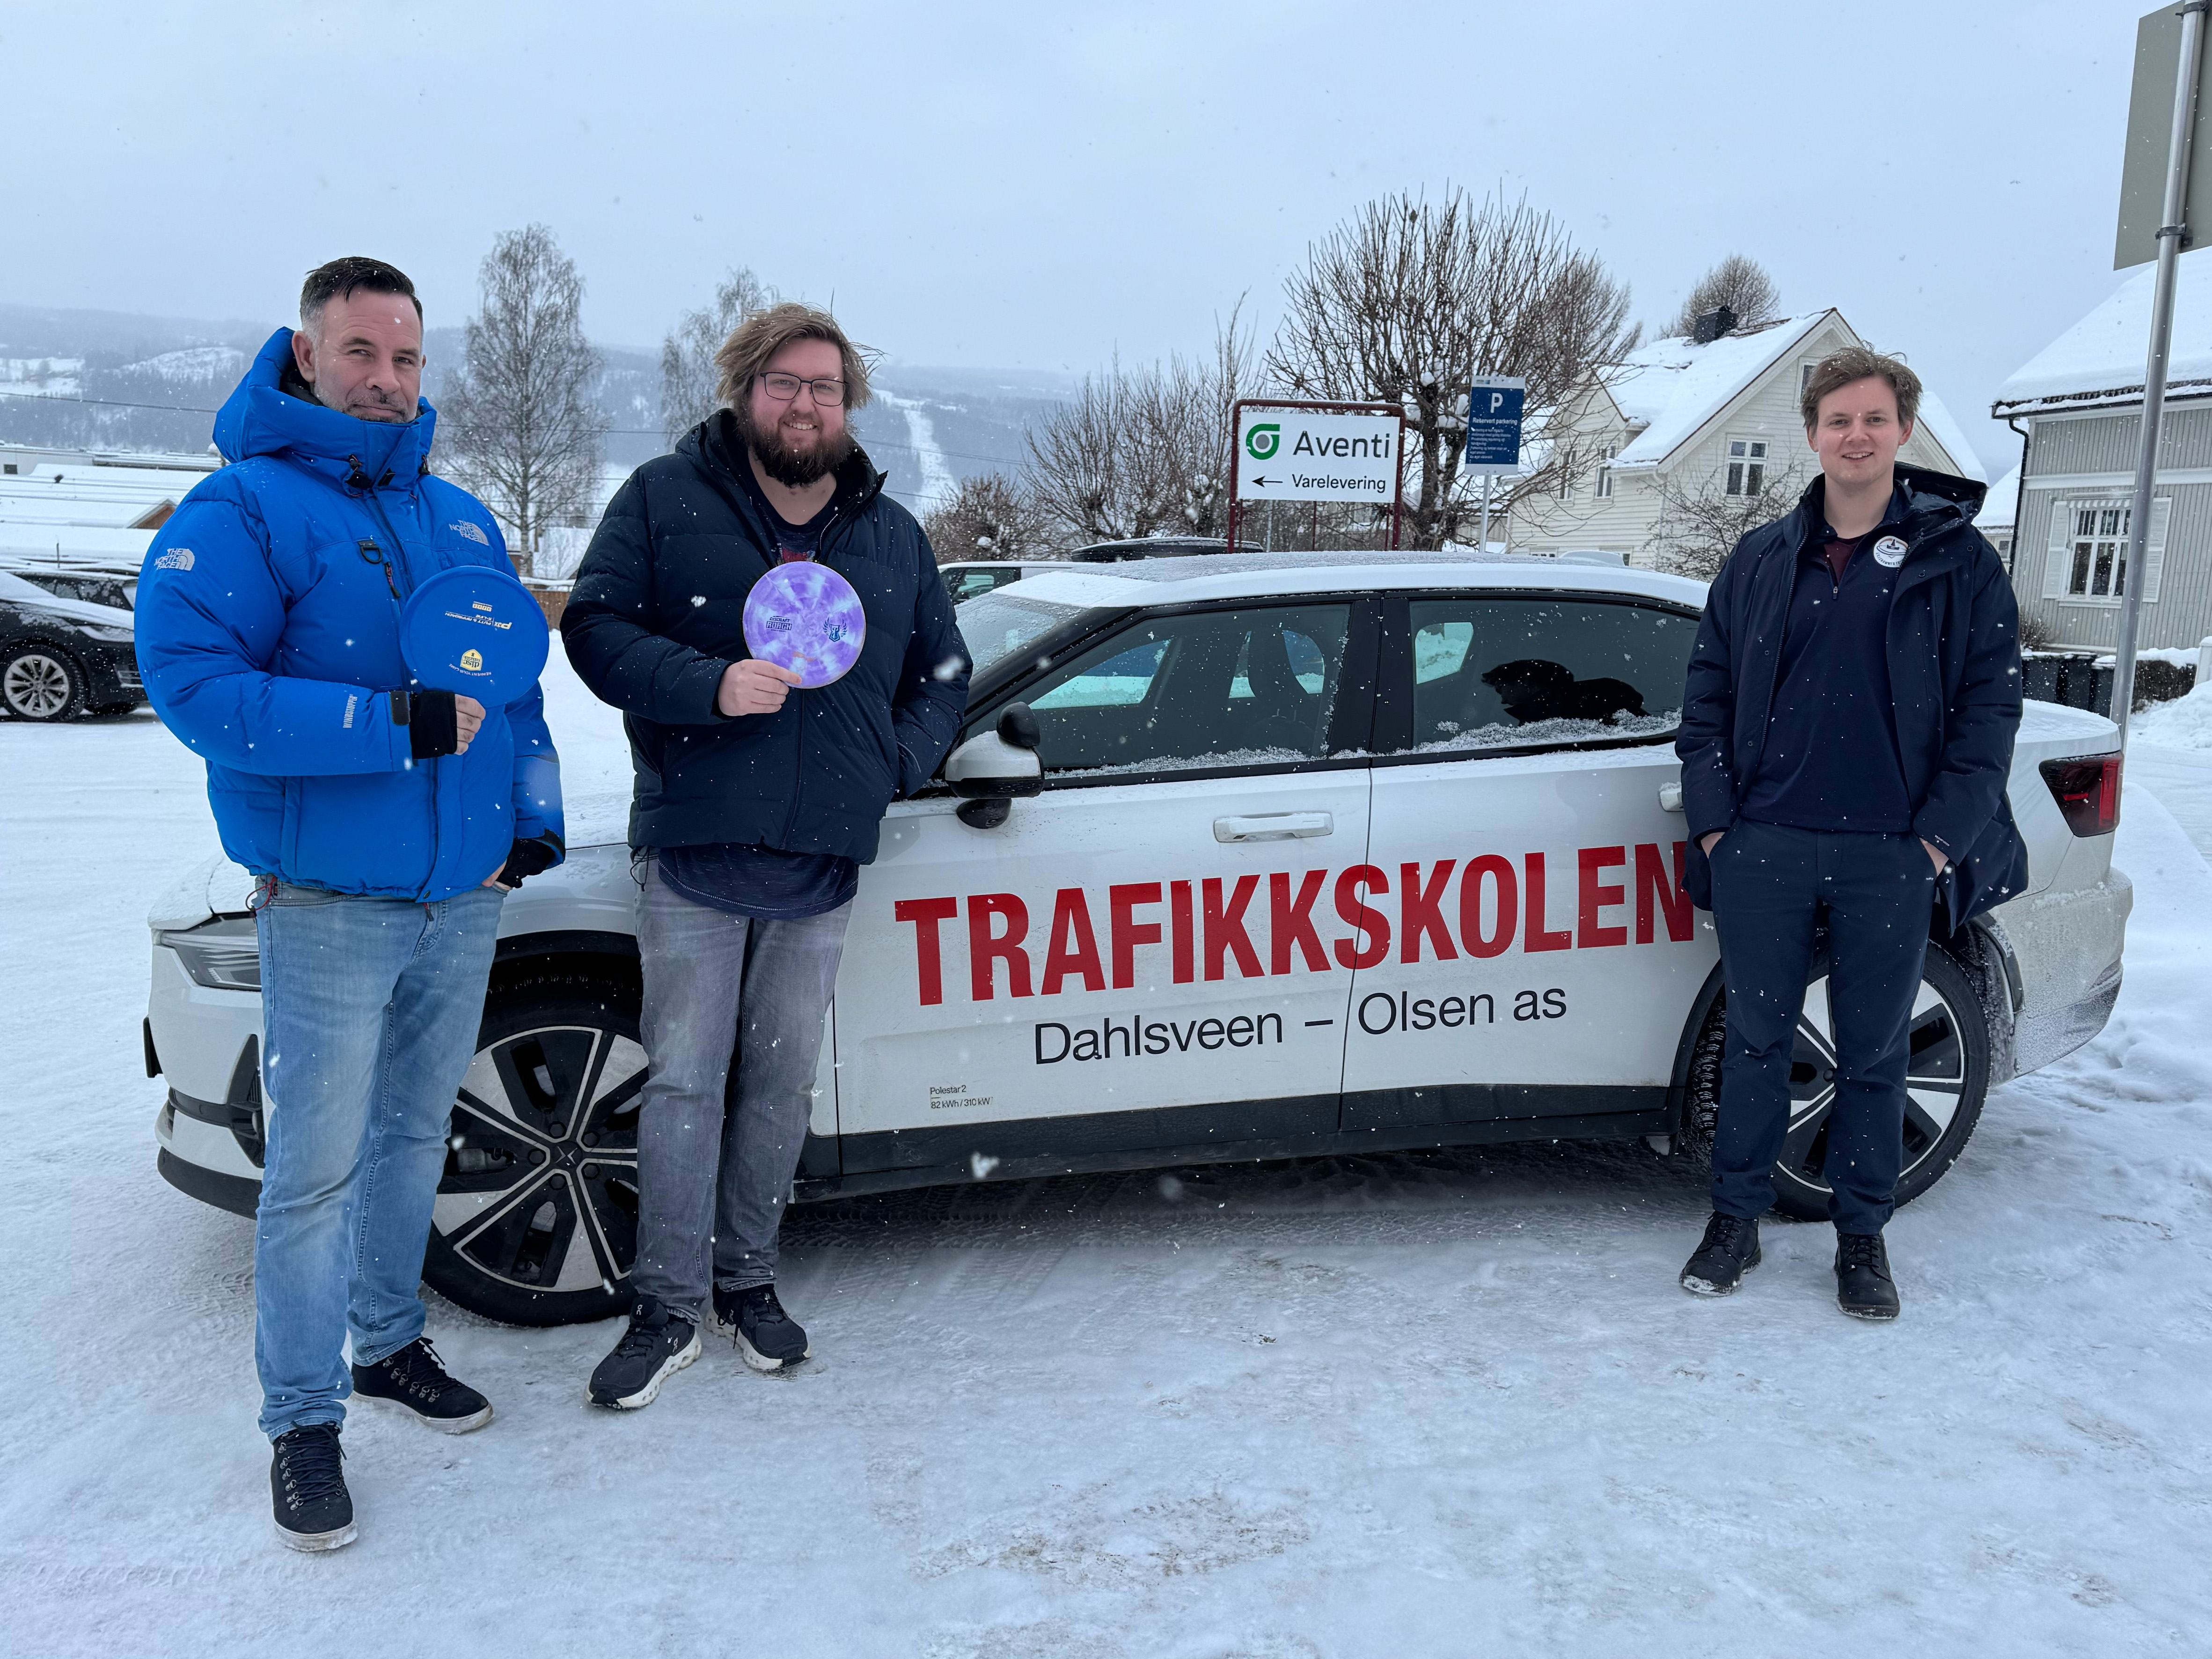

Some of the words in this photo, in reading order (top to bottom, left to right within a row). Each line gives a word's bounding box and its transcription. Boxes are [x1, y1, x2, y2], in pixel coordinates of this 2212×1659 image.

[1490, 392, 1503, 413] P
[1293, 430, 1390, 458] Aventi
[1292, 474, 1386, 493] Varelevering
[449, 523, 474, 535] NORTH
[458, 520, 473, 529] THE
[460, 530, 479, 542] FACE
[154, 555, 179, 566] NORTH
[156, 561, 178, 570] FACE
[894, 840, 1694, 1006] TRAFIKKSKOLEN
[1035, 1011, 1282, 1064] Dahlsveen
[1358, 991, 1494, 1035] Olsen
[1513, 988, 1567, 1021] as
[930, 1086, 961, 1094] Polestar
[931, 1101, 941, 1109] 82
[942, 1100, 959, 1108] kWh
[964, 1098, 977, 1107] 310
